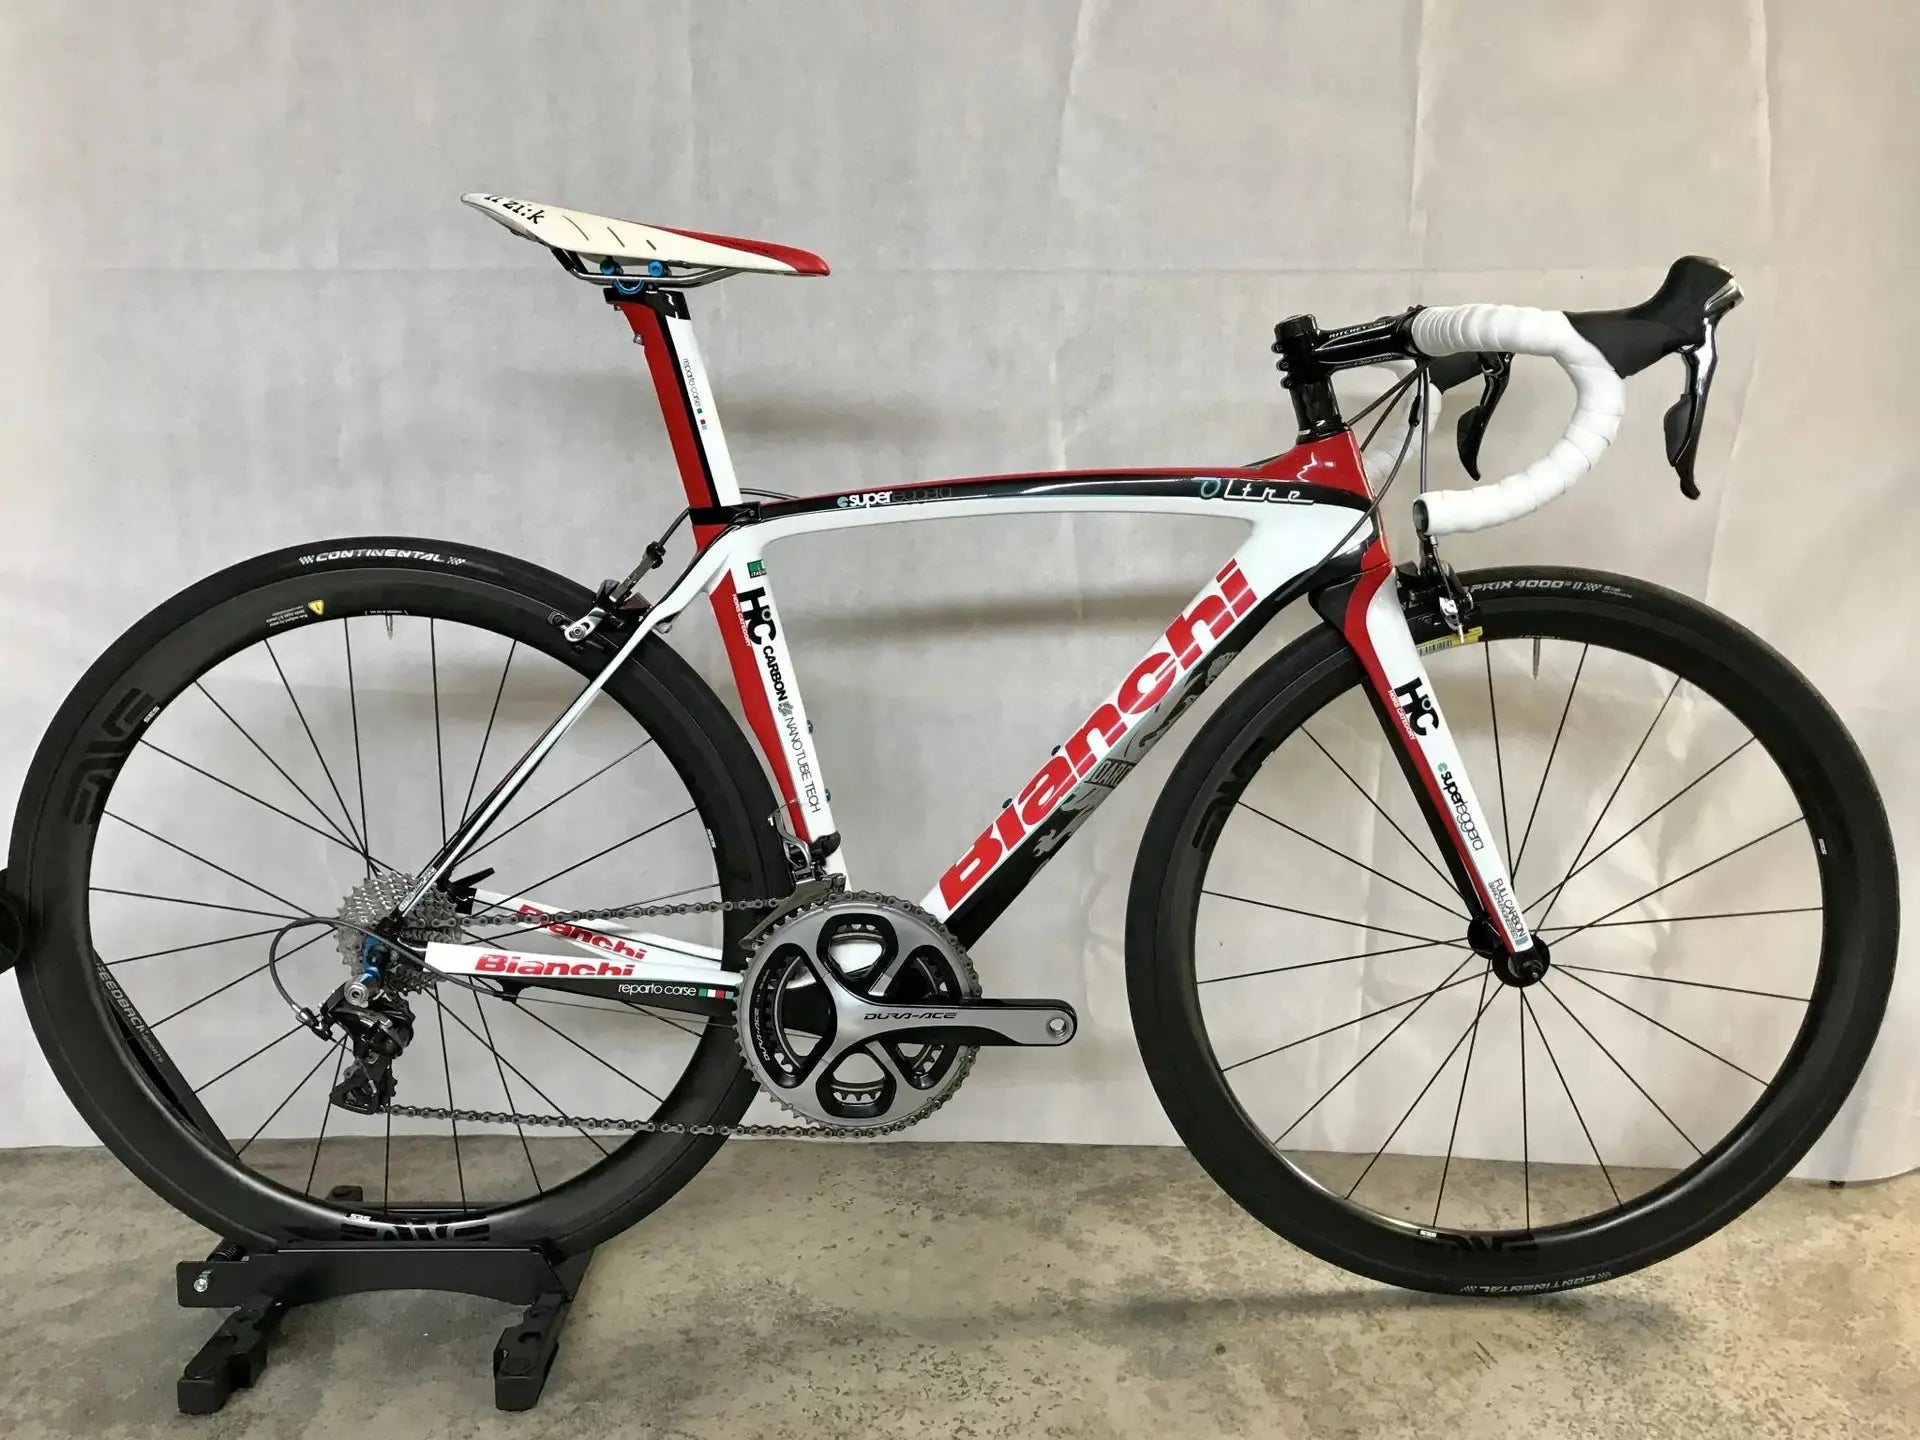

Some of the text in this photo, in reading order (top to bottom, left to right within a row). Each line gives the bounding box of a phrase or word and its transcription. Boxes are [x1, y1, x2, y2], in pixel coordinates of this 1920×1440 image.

[315, 548, 445, 562] CONTINENTAL
[1470, 580, 1513, 593] PRIX
[737, 612, 751, 648] CATEGORY
[763, 645, 788, 701] CARBON
[804, 780, 821, 813] TECH
[939, 558, 1258, 911] Bianchi
[1394, 706, 1417, 741] CATEGORY
[1441, 770, 1485, 851] superleggera
[1493, 877, 1527, 937] FULL CARBON
[518, 904, 647, 960] Banchi
[475, 953, 636, 977] Bianchi
[618, 982, 697, 998] reparto corse
[864, 1011, 959, 1021] DURA-ACE
[1479, 1274, 1597, 1293] CONTINENTAL
